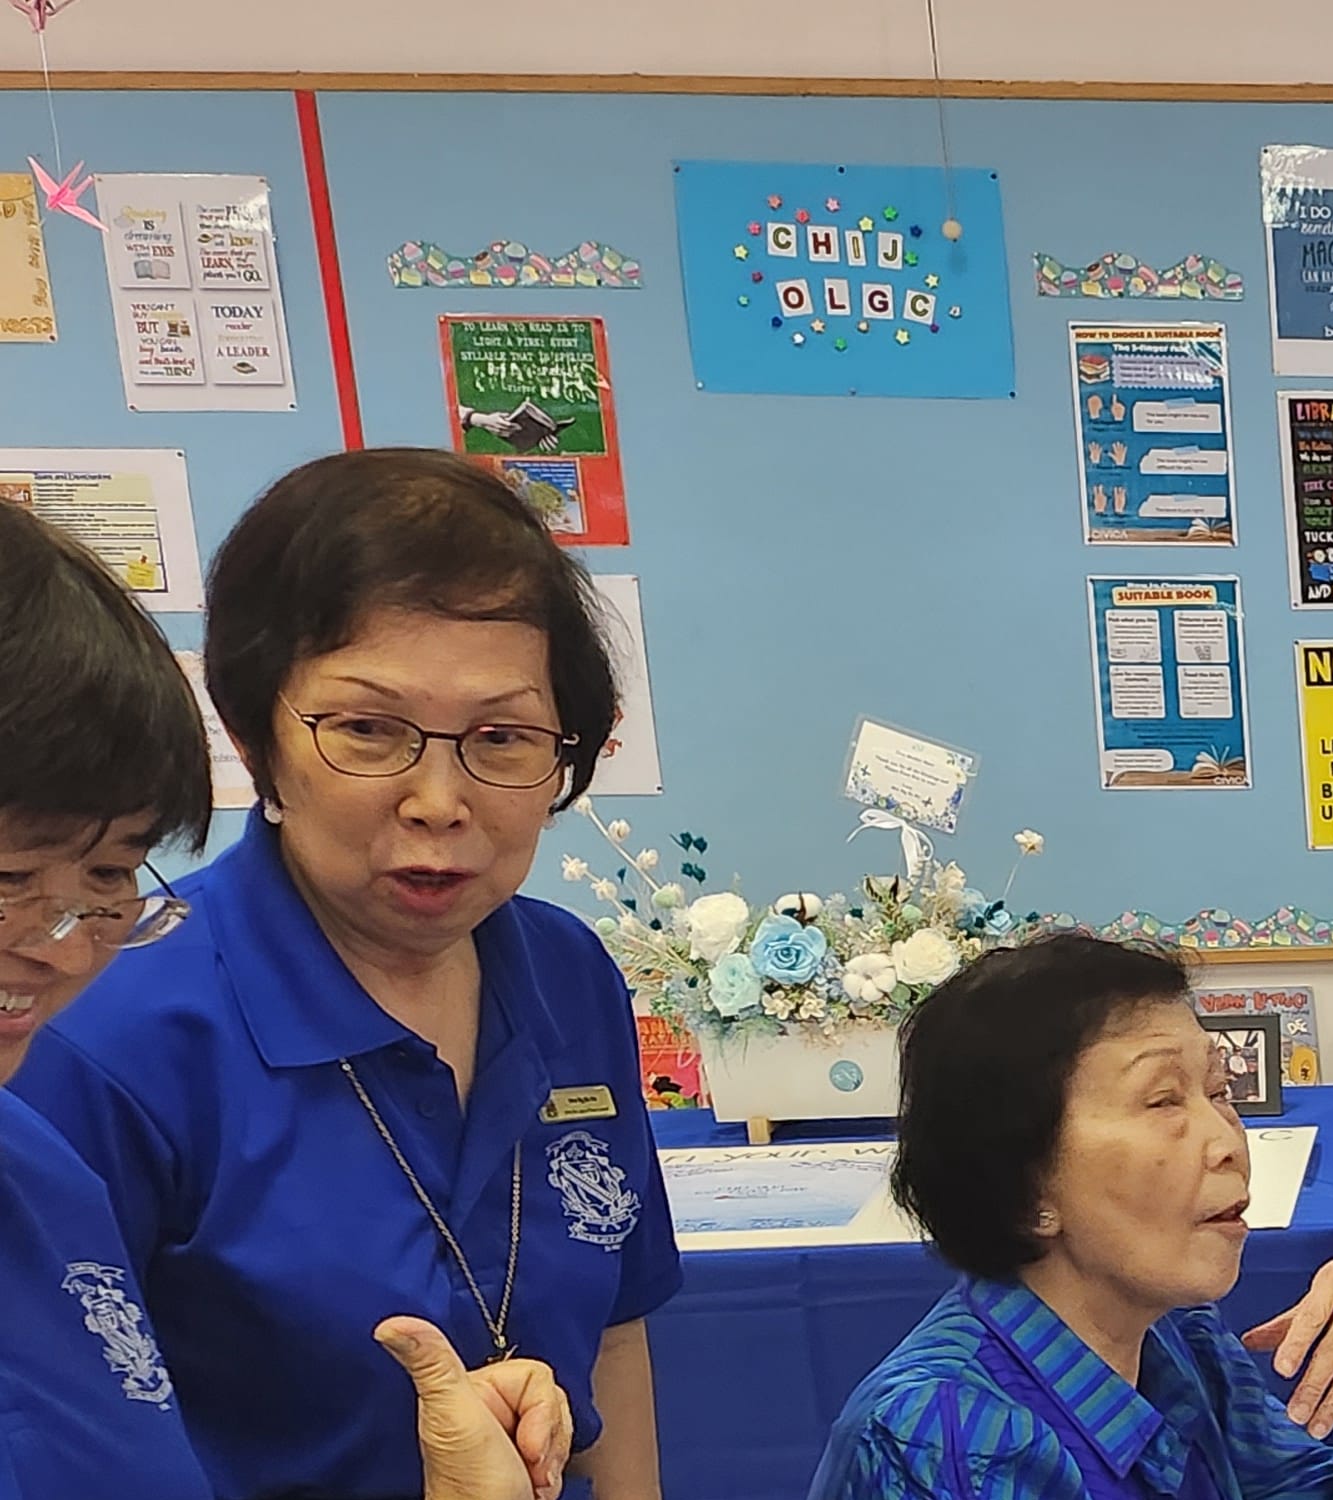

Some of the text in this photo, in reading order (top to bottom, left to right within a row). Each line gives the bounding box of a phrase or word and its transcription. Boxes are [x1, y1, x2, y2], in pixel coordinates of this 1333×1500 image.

[1310, 206, 1331, 219] DO
[151, 245, 175, 257] EYES
[211, 305, 263, 319] TODAY
[136, 321, 160, 334] BUT
[226, 346, 270, 357] LEADER
[1305, 531, 1333, 542] TUCK
[1118, 590, 1212, 601] SUITABLE BOOK
[1308, 585, 1331, 599] AND
